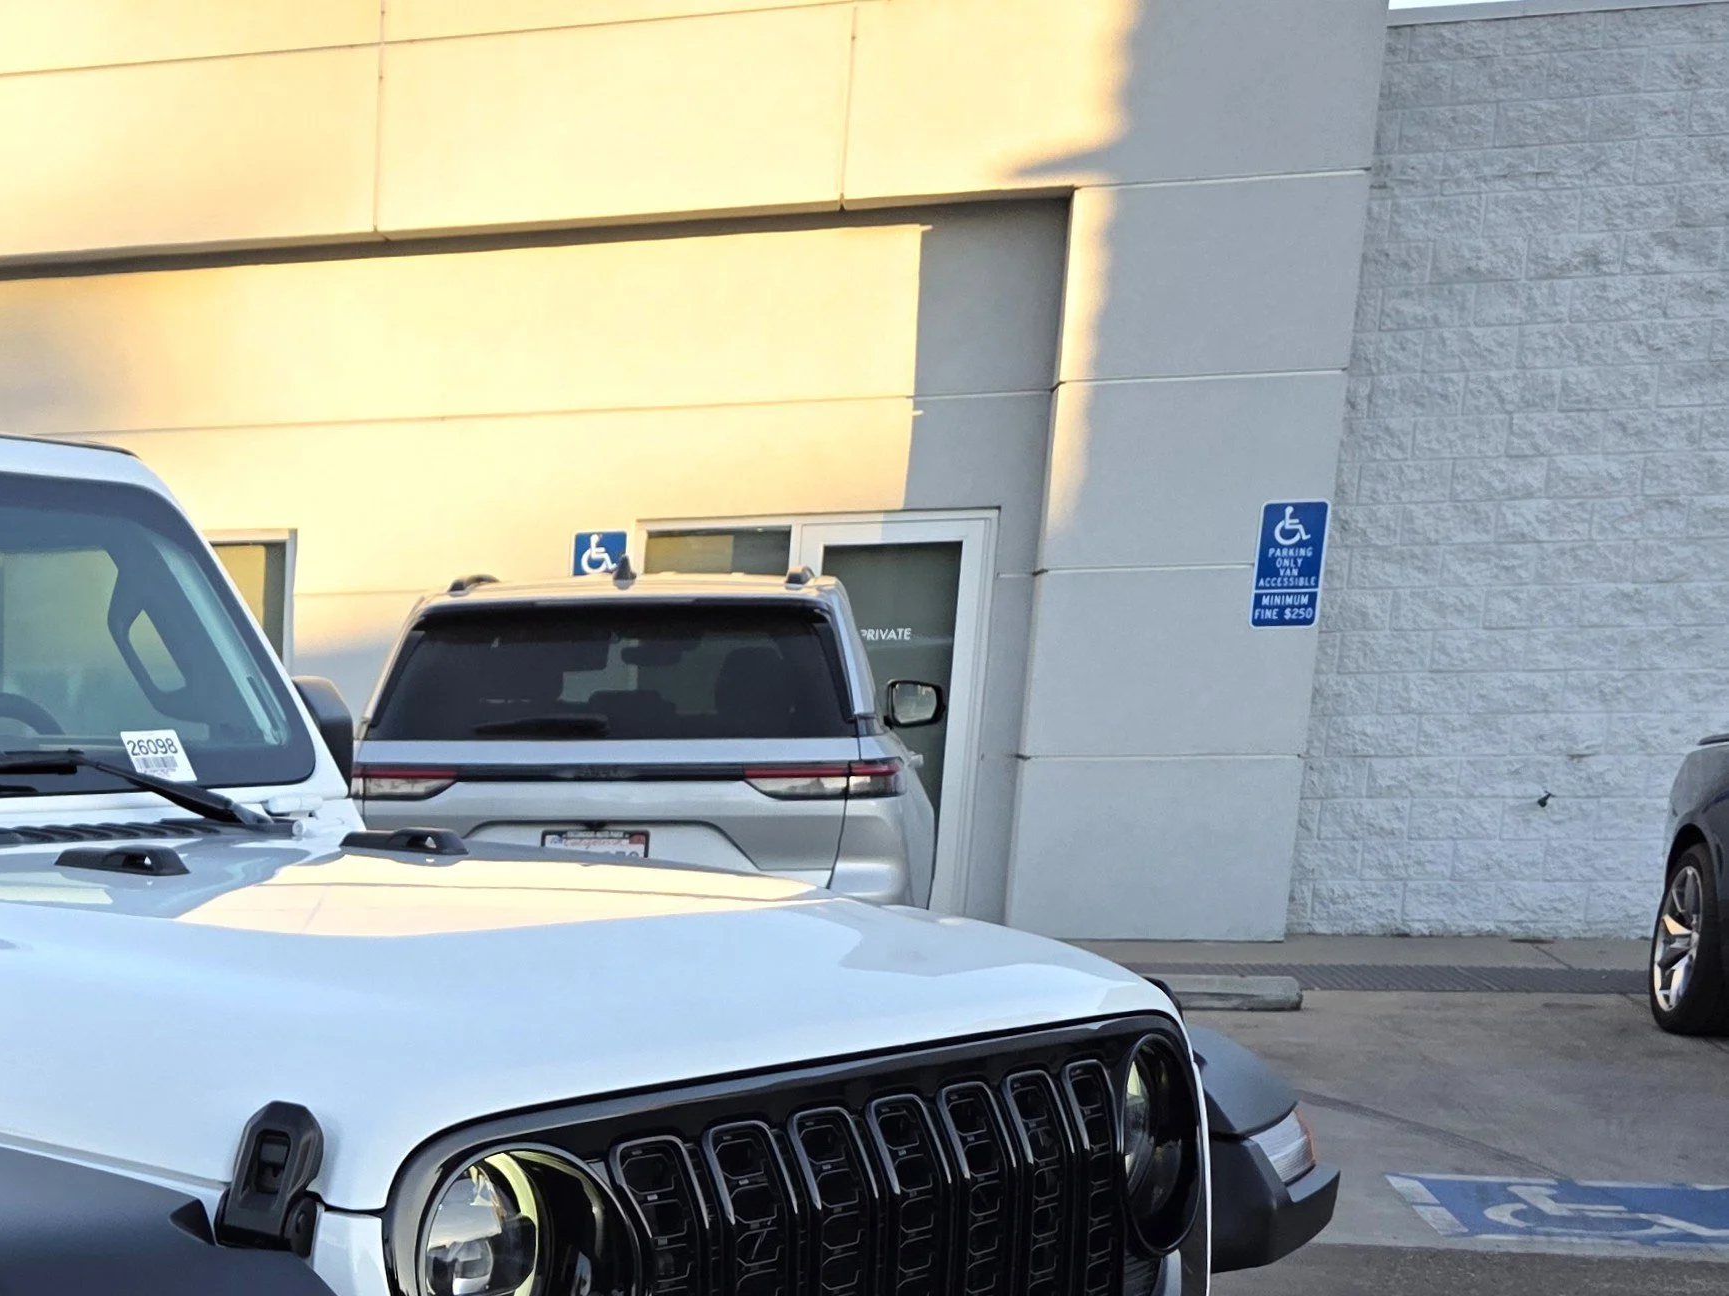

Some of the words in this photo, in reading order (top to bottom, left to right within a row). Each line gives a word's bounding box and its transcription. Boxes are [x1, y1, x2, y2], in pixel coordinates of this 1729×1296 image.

[1268, 546, 1313, 557] PARKING
[1275, 557, 1303, 568] ONLY
[1279, 567, 1299, 576] VAN
[1258, 577, 1316, 587] ACCESSIBLE
[1261, 594, 1309, 605] MINIMUM
[1254, 608, 1279, 620] FINE
[1283, 607, 1313, 620] $250
[127, 738, 178, 756] 26098
